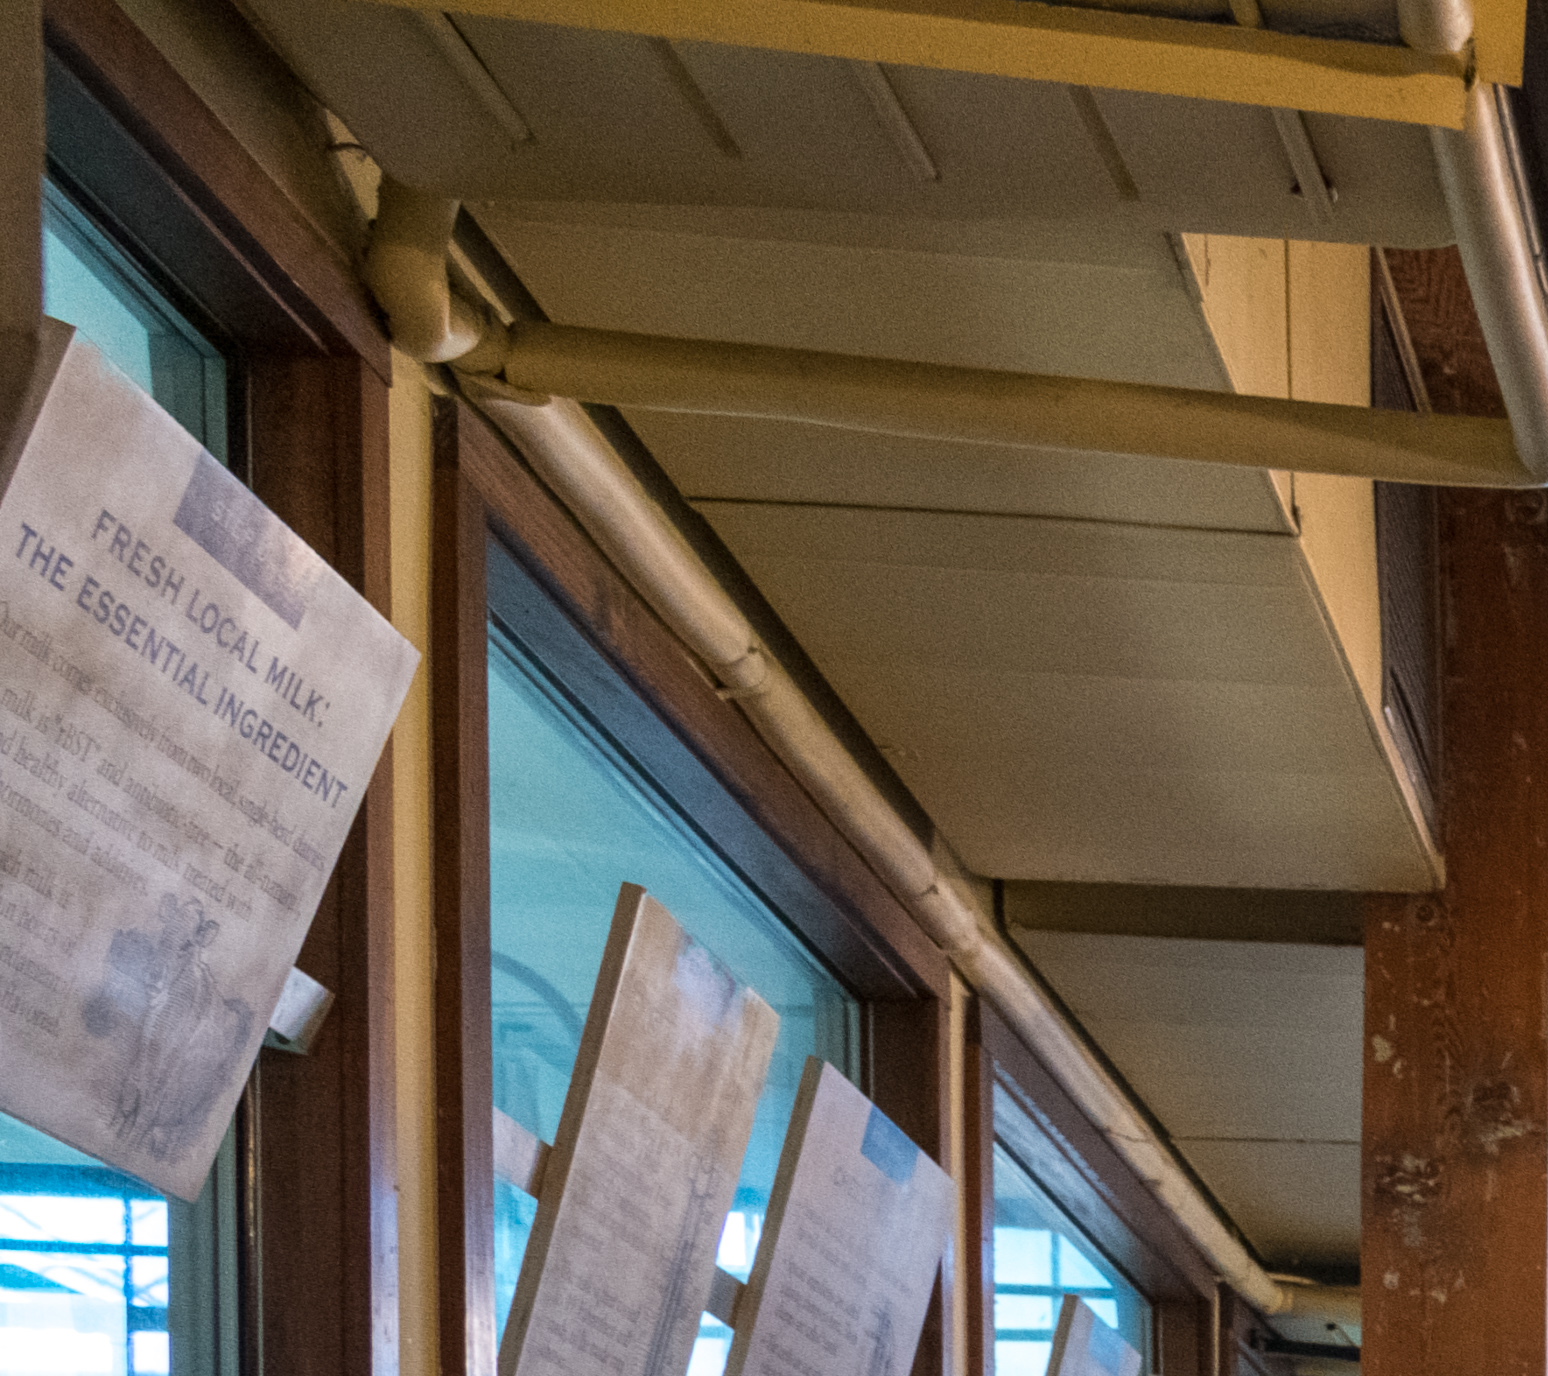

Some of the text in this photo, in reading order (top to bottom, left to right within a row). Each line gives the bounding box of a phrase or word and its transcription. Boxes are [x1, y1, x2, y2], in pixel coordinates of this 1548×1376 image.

[14, 522, 347, 808] THE ESSENTIAL INGREDIENT
[91, 509, 186, 603] FRESH
[185, 588, 258, 674] LOCAL
[266, 657, 331, 728] MILK:
